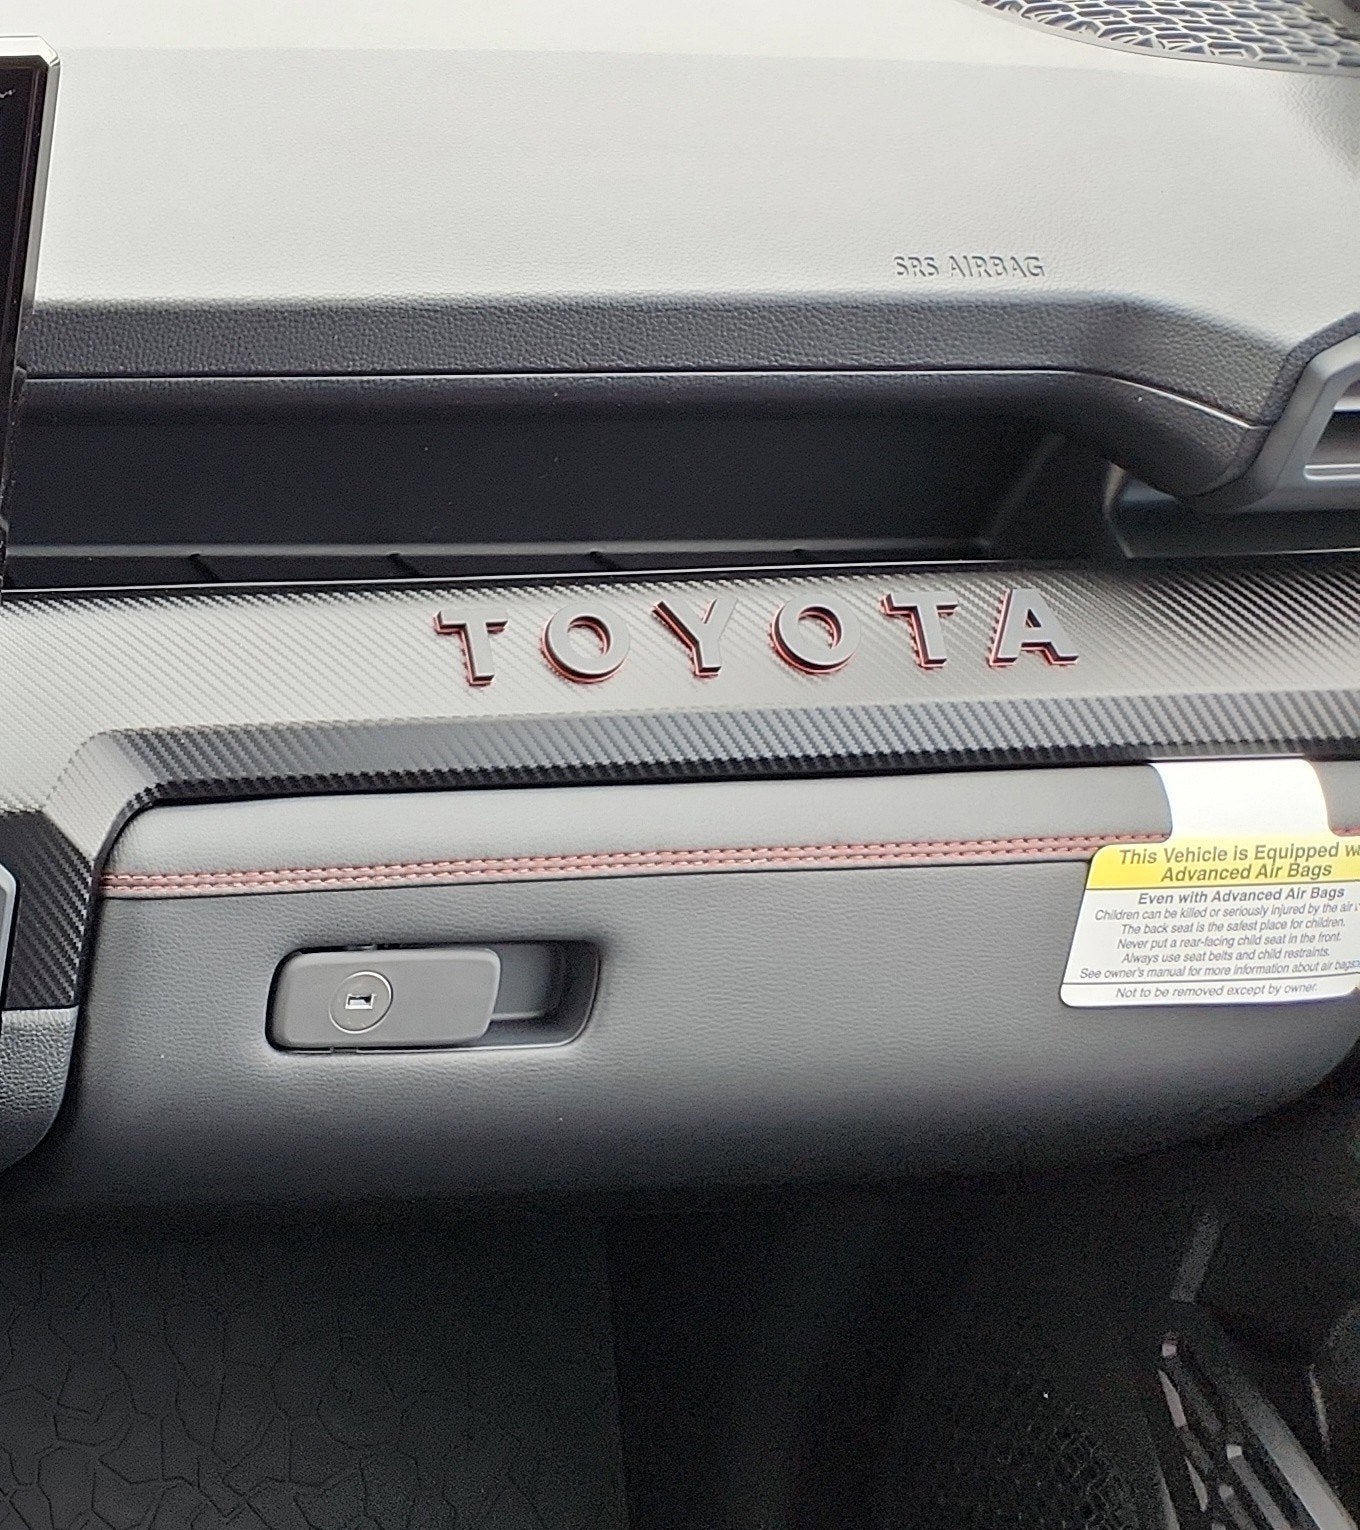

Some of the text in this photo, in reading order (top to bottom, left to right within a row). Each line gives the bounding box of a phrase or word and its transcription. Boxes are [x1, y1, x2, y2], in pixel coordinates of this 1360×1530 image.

[893, 255, 1045, 278] SRS AIRBAG
[433, 588, 1079, 687] TOYOTA
[1120, 850, 1157, 864] This
[1164, 846, 1227, 863] Vehicle
[1234, 846, 1248, 860] is
[1255, 842, 1339, 862] Equipped
[1160, 864, 1332, 882] Advanced Air Bags
[1138, 887, 1345, 905] Even with Advanced Air Bags
[1095, 909, 1139, 920] Children
[1142, 910, 1161, 920] can
[1164, 908, 1177, 919] be
[1180, 907, 1206, 918] killed
[1210, 908, 1220, 917] or
[1223, 905, 1269, 917] seriously
[1271, 904, 1305, 916] injured
[1308, 904, 1320, 916] by
[1323, 902, 1338, 913] the
[1340, 902, 1353, 912] air
[1121, 918, 1345, 934] The back seat is the safest place for children.
[1116, 988, 1137, 998] Not
[1140, 987, 1151, 997] to
[1155, 987, 1169, 997] be
[1173, 985, 1223, 996] removed
[1227, 985, 1265, 996] except
[1268, 984, 1281, 995] by
